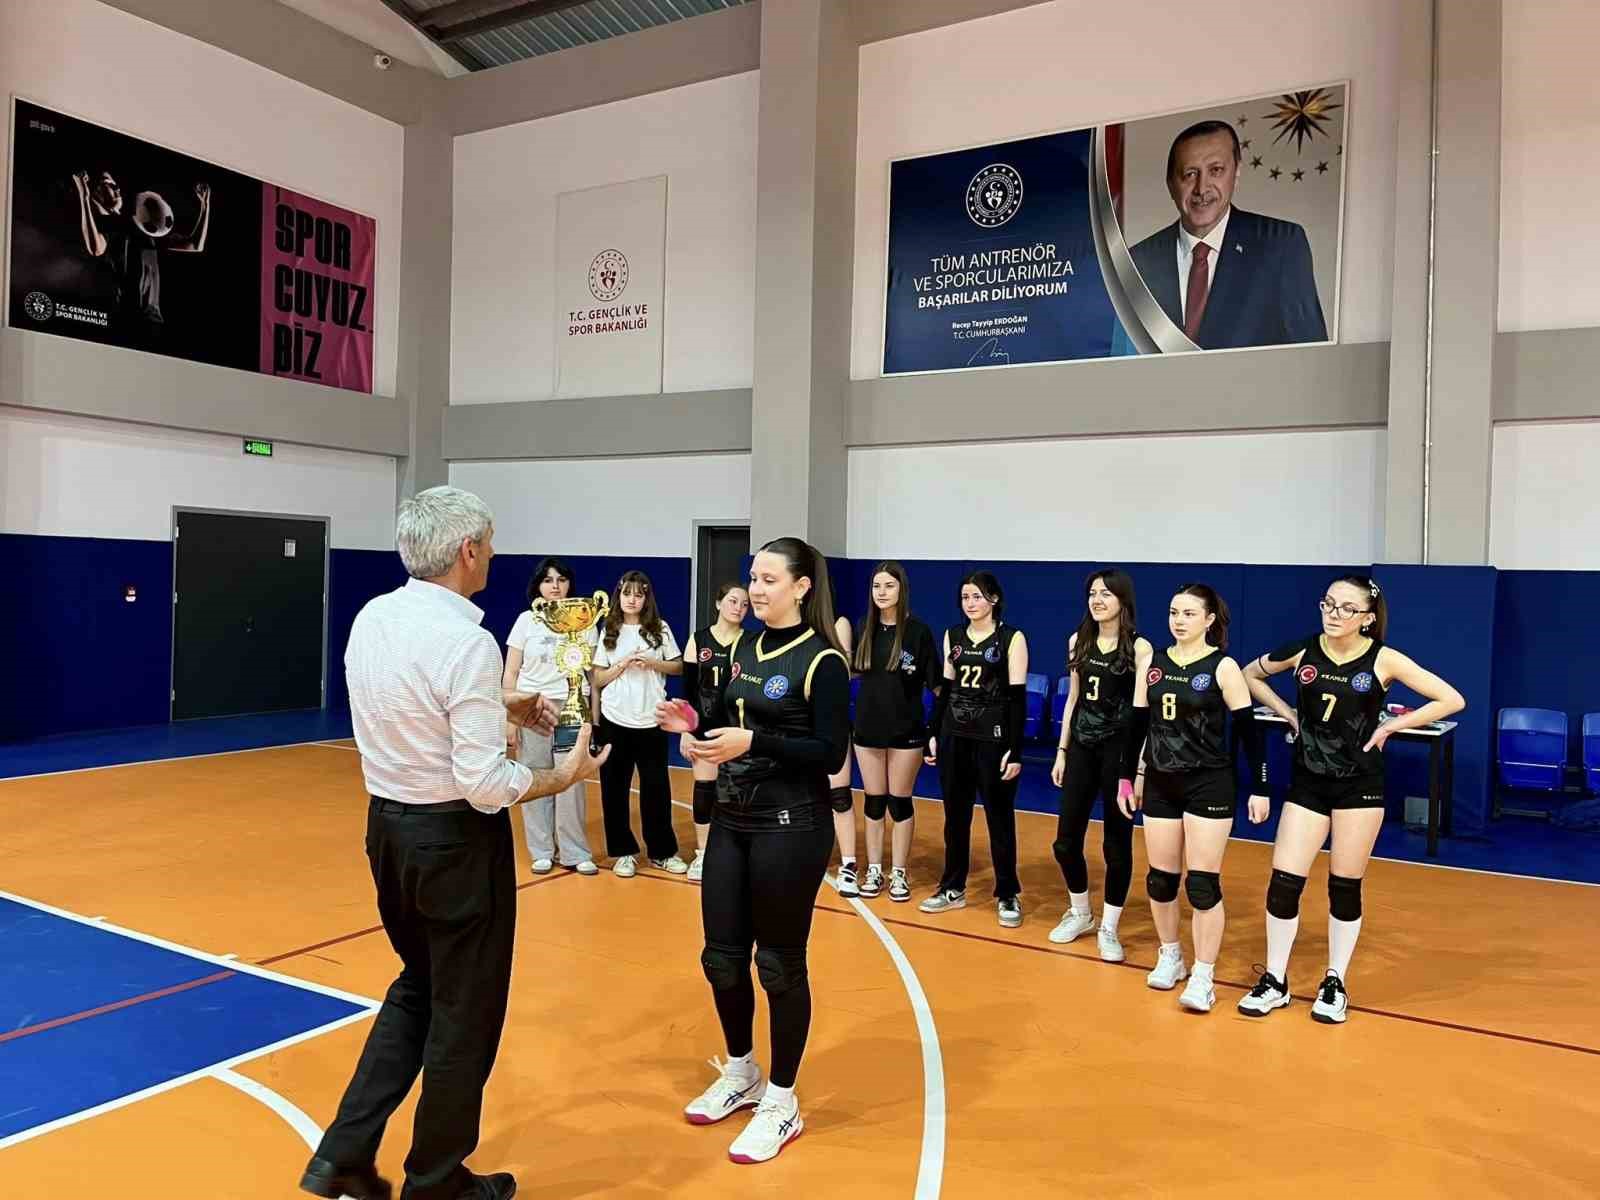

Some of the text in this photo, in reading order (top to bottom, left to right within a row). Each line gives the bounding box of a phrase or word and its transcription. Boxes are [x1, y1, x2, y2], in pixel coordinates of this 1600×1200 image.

[275, 204, 351, 271] SPOR
[931, 243, 1056, 273] TÜM ANTRENÖR
[913, 260, 1074, 292] VE SPORCULARIMIZA
[274, 264, 367, 331] CUYUZ
[918, 281, 1068, 310] BAŞARILAR DİLİYORUM
[55, 310, 72, 319] SPOR
[68, 305, 98, 317] GENÇLİK
[568, 304, 648, 322] T.C. GENÇLİK VE
[994, 315, 1028, 325] ERDOĞAN
[568, 317, 648, 336] SPOR BAKANLIĞI
[965, 327, 1026, 338] CUMHURBAŞKANI
[273, 321, 322, 379] BİZ
[960, 665, 983, 688] 22
[1086, 676, 1101, 701] 3
[735, 697, 745, 730] 1
[1161, 693, 1177, 721] 8
[1322, 692, 1337, 722] 7
